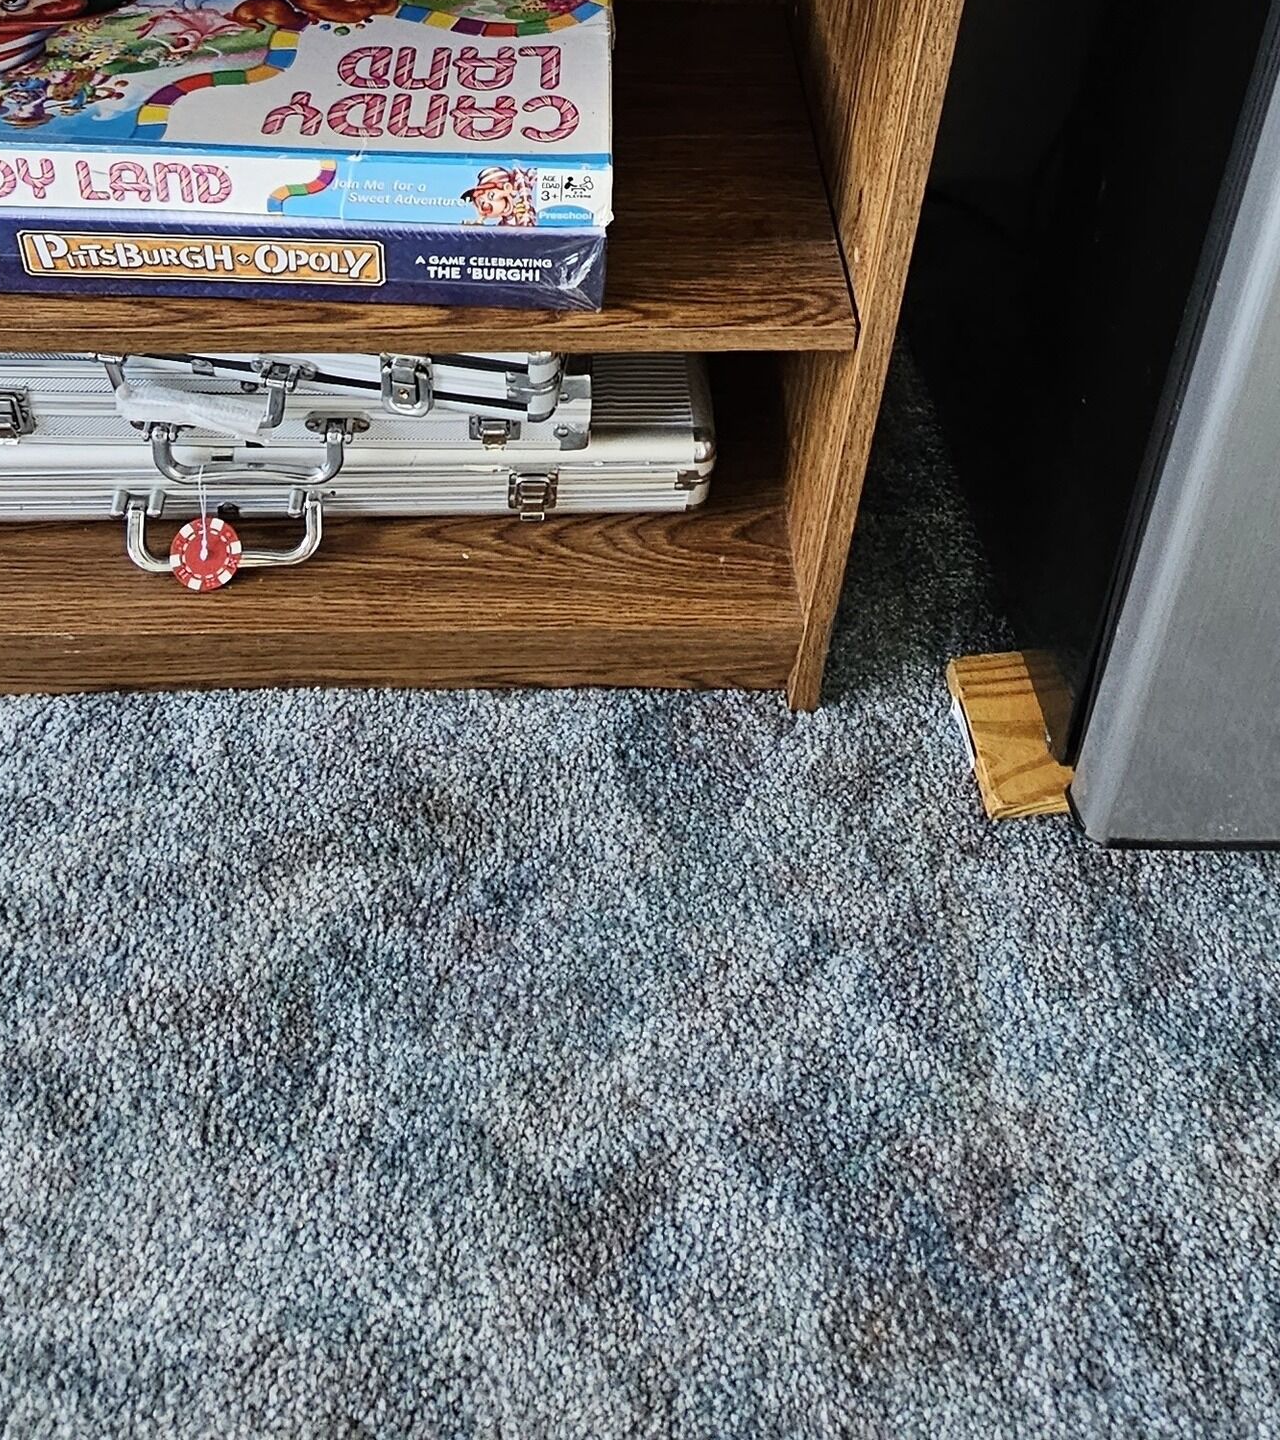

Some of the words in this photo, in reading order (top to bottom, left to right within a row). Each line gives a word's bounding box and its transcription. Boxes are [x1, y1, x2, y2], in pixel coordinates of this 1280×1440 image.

[337, 45, 563, 91] LAND
[261, 91, 581, 143] CANDY
[76, 160, 233, 204] LAND
[334, 178, 360, 191] Join
[364, 179, 385, 191] Me
[394, 180, 414, 192] for
[416, 183, 427, 193] a
[348, 191, 391, 205] Sweet
[541, 190, 559, 201] 3+
[539, 211, 593, 220] Preschool
[415, 255, 426, 265] A
[429, 255, 466, 266] GAME
[469, 256, 553, 269] CELEBRATING
[427, 266, 462, 279] THE
